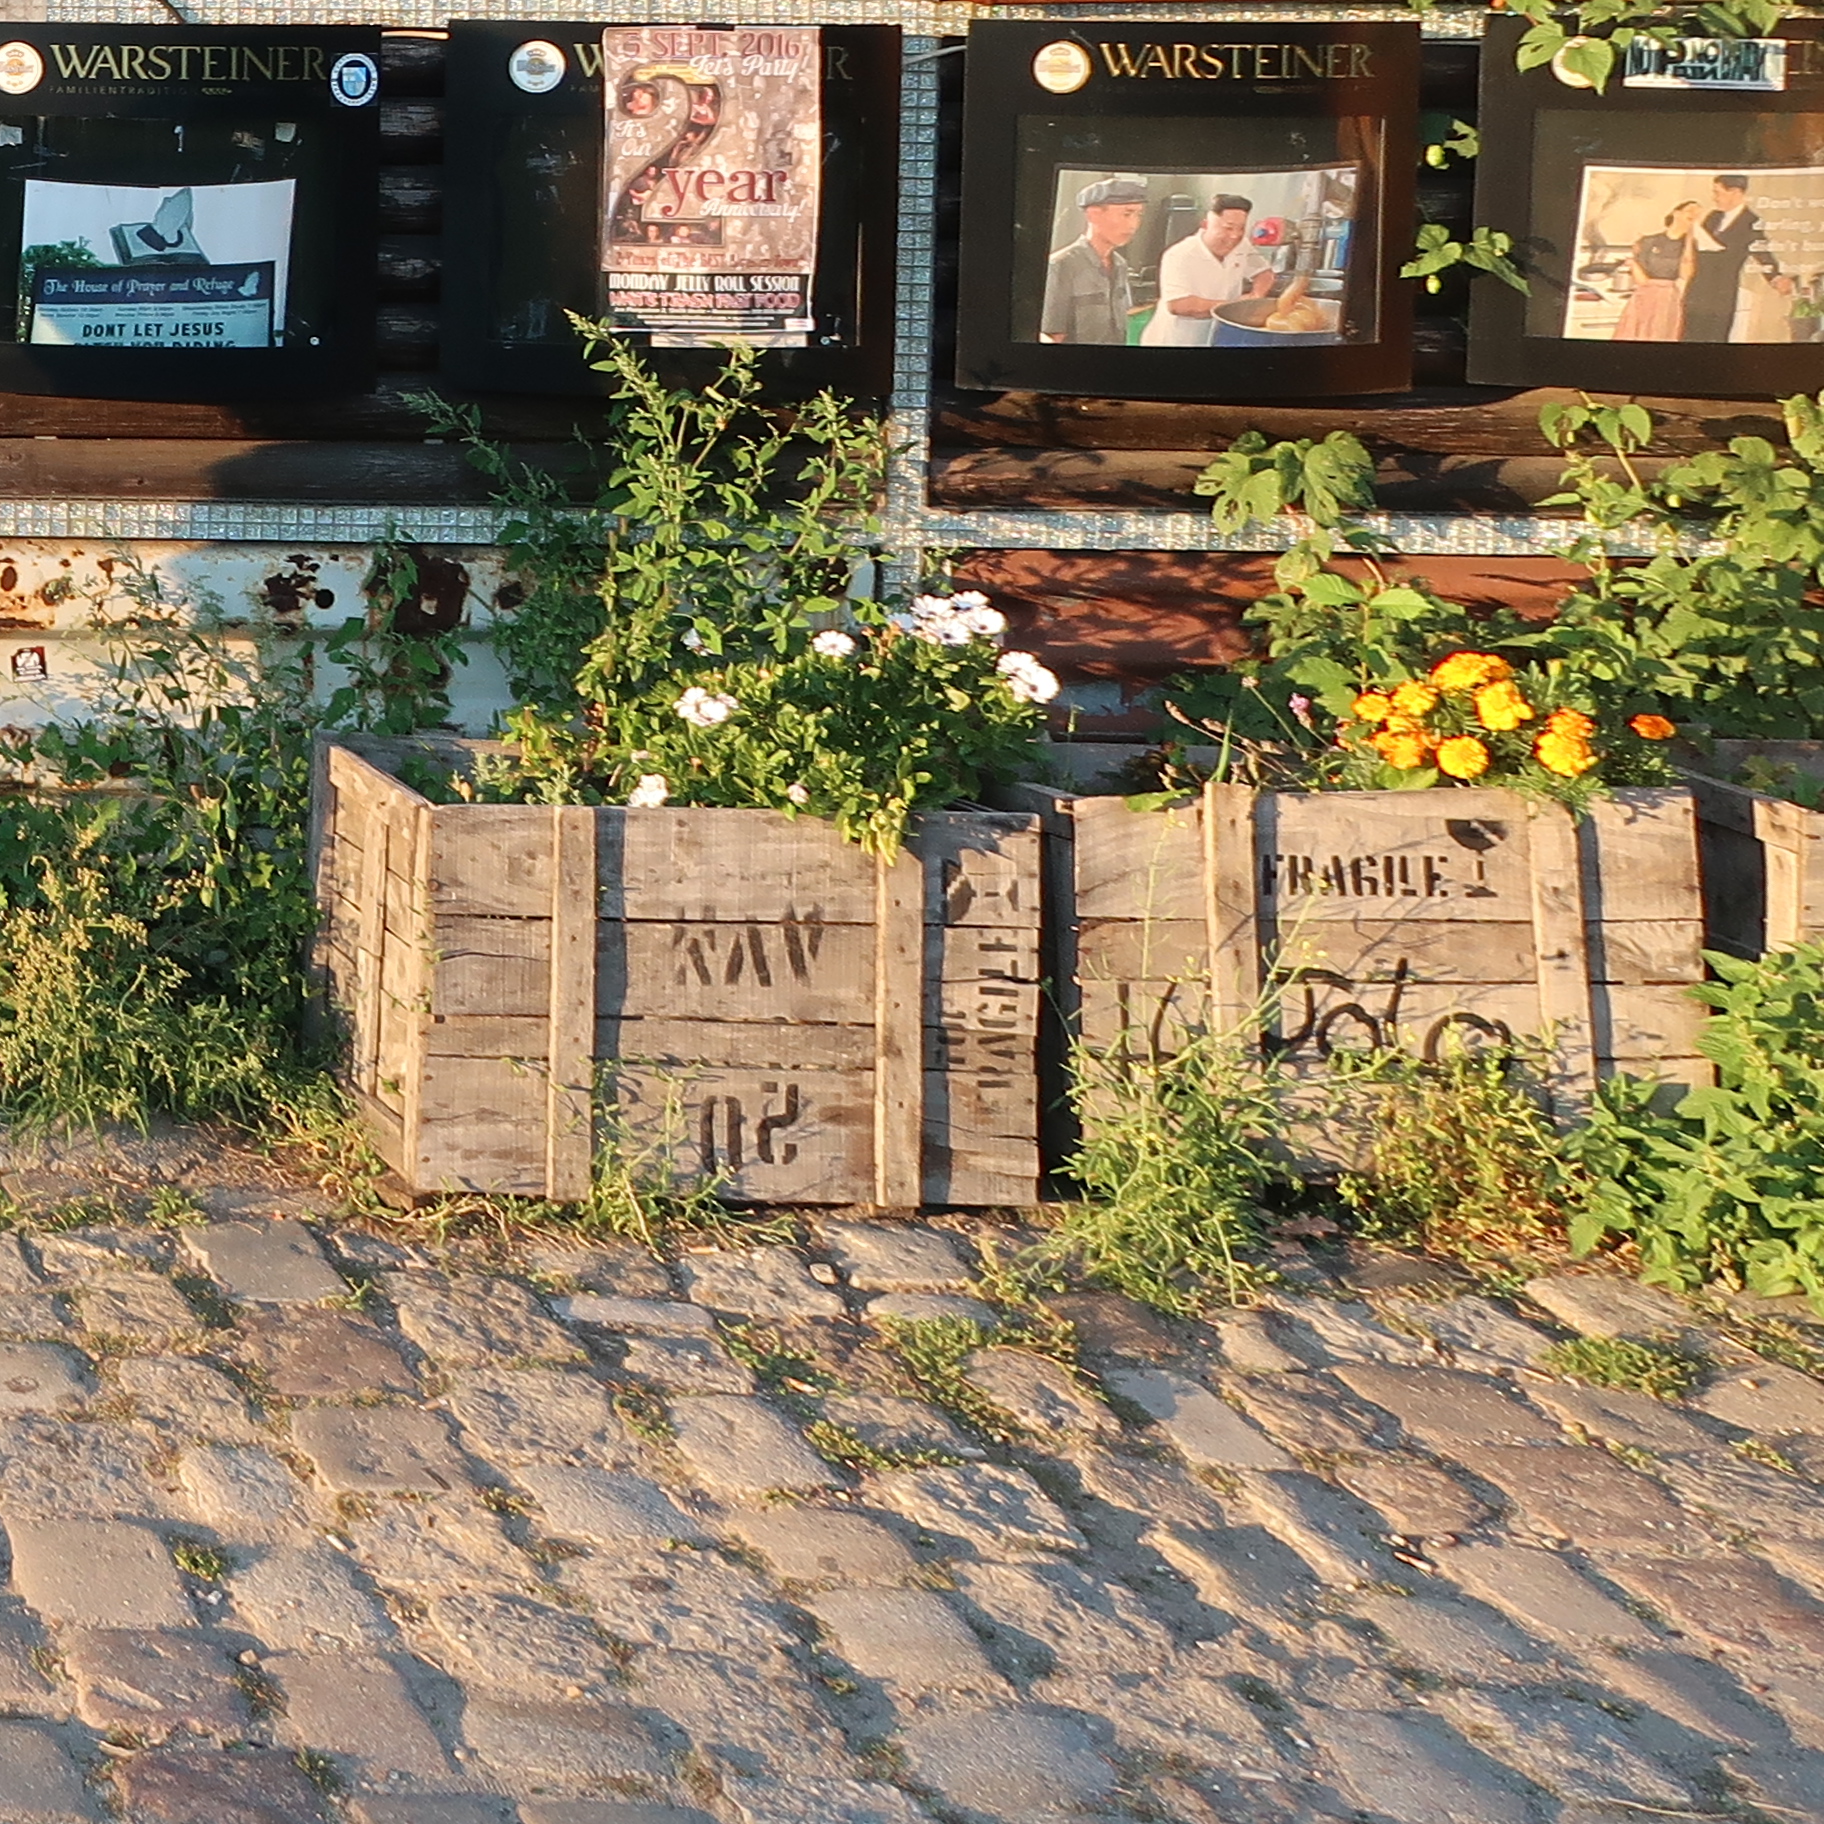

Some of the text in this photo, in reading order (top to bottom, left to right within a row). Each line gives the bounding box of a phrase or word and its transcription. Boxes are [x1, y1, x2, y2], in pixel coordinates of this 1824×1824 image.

[742, 32, 801, 59] 2016
[49, 44, 328, 82] WARSTEINER
[1100, 43, 1376, 79] WARSTEINER
[662, 168, 787, 218] year
[44, 277, 235, 297] The House of Prayer and Refuge
[608, 273, 669, 290] MONDAY
[714, 275, 747, 291] ROLL
[749, 275, 800, 291] SESSION
[754, 293, 801, 309] FOOD
[83, 322, 225, 338] DONT LET JESUS
[1261, 854, 1449, 898] FRAGILE
